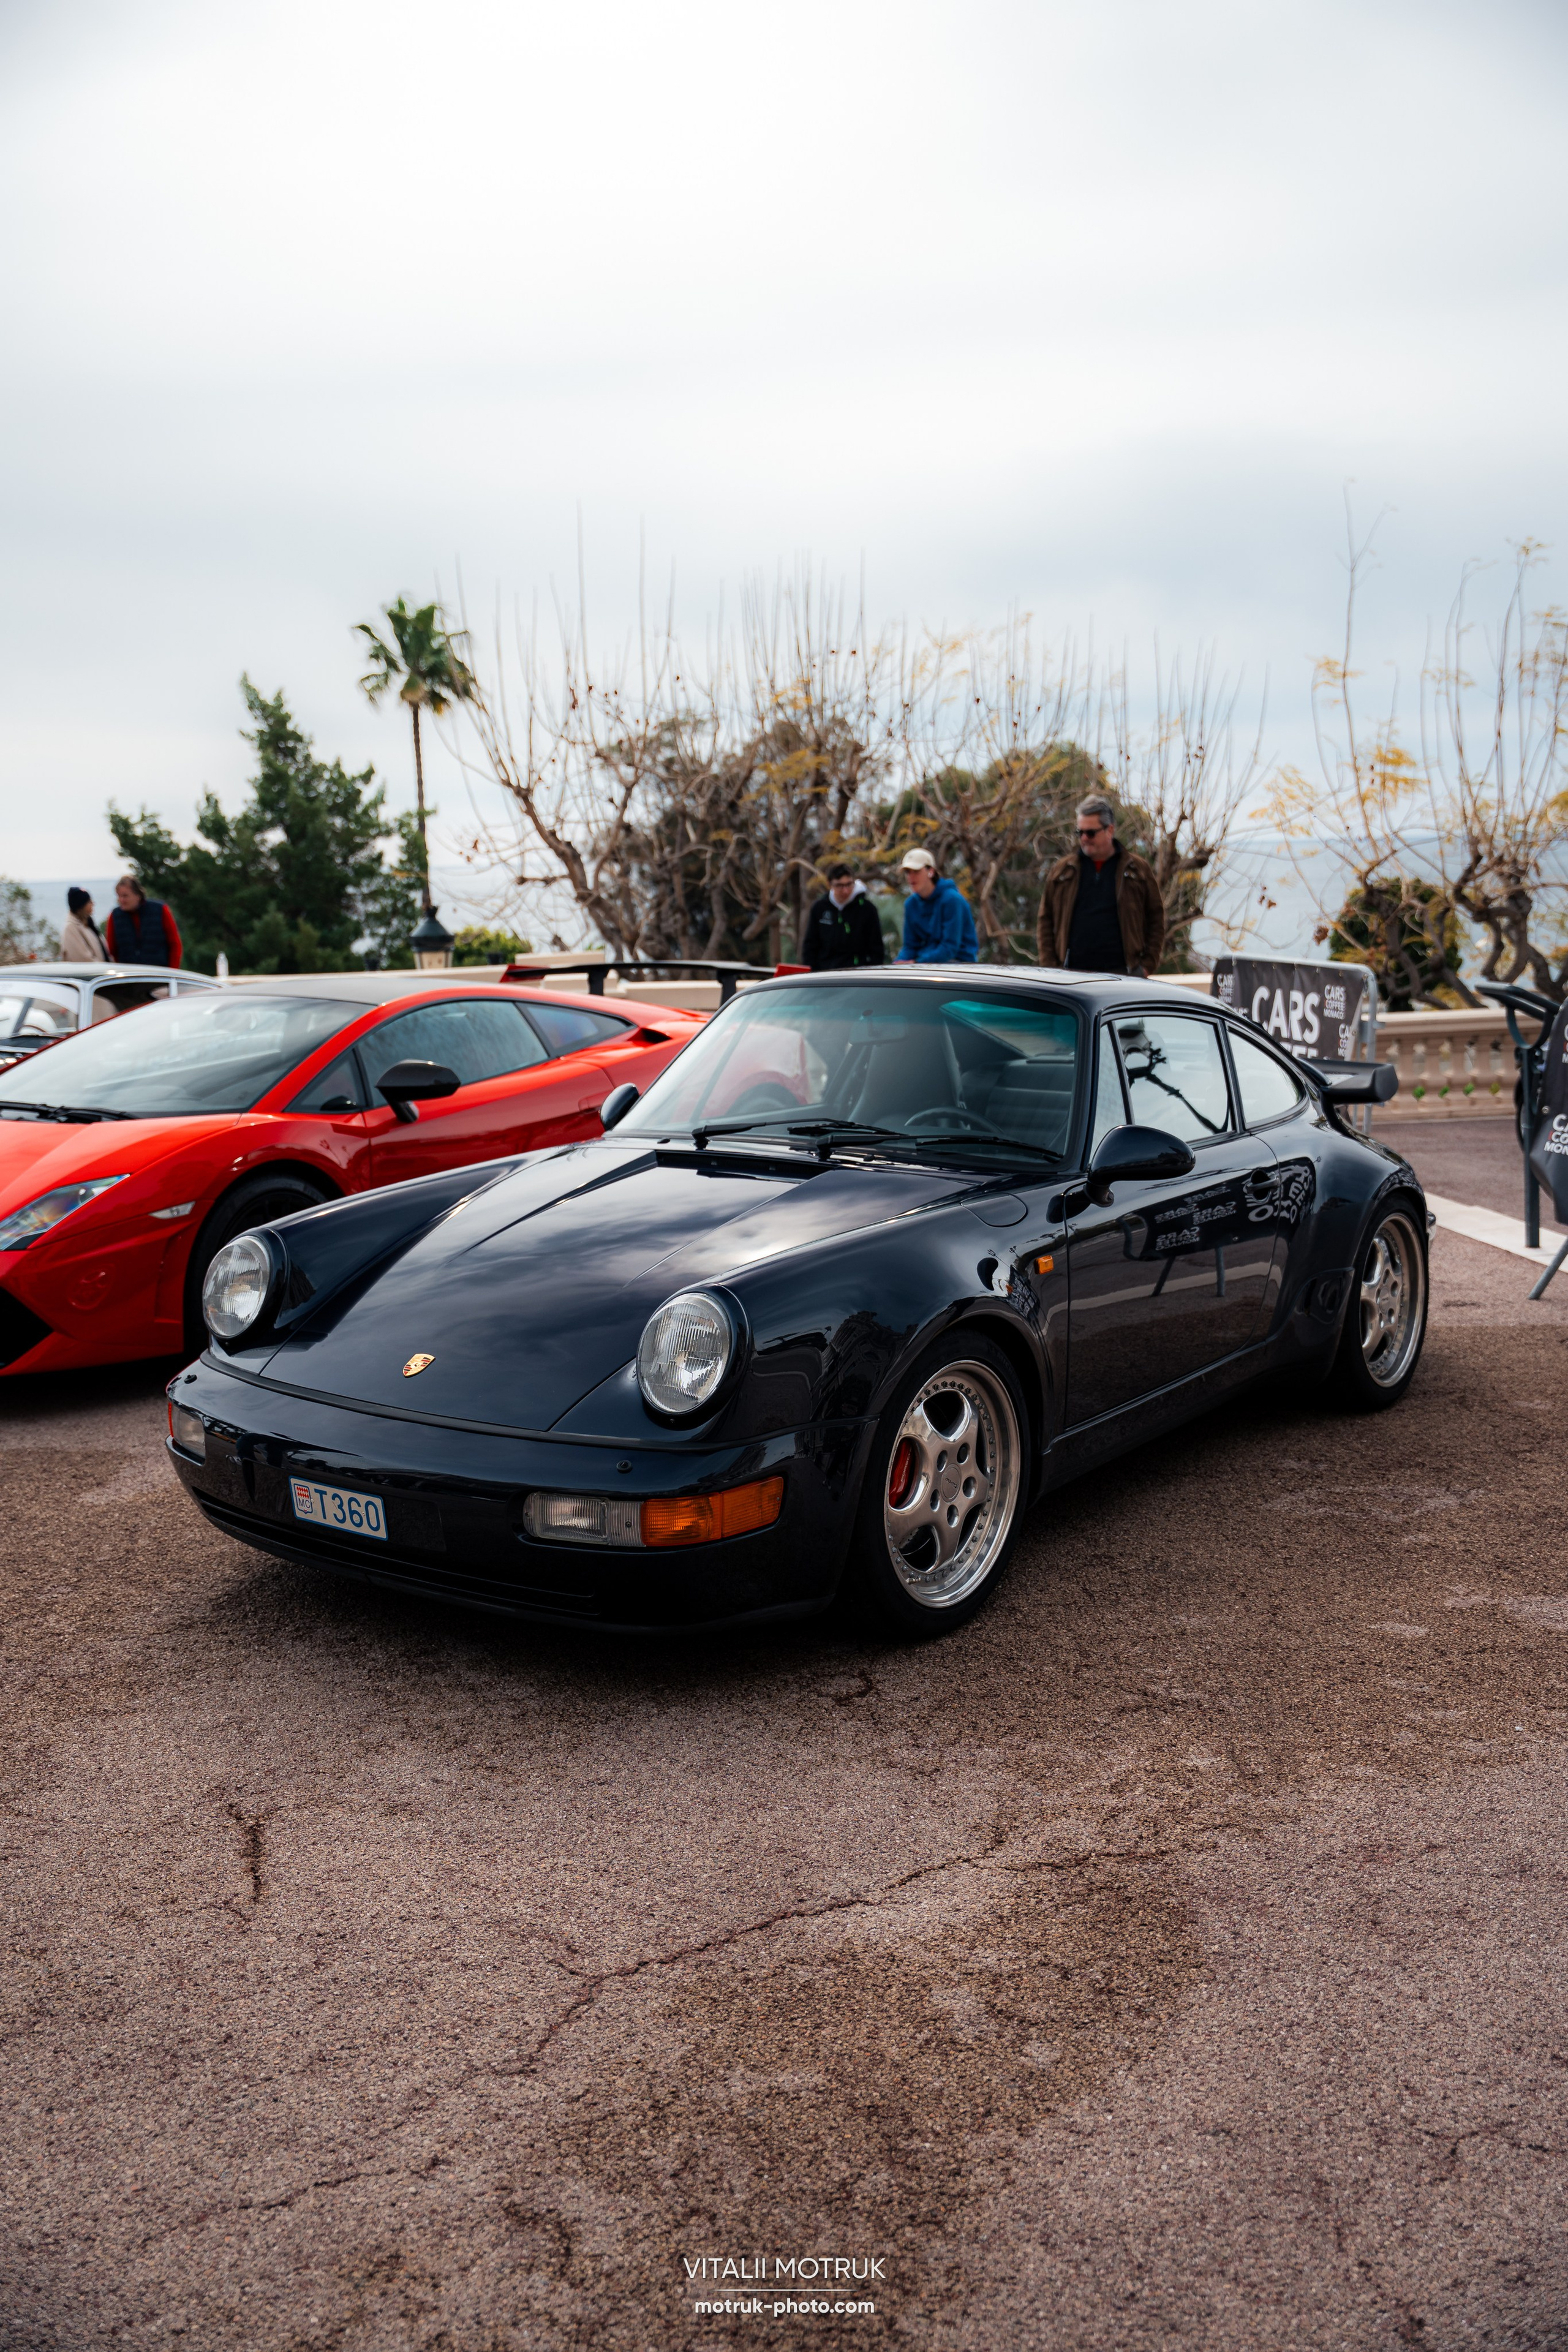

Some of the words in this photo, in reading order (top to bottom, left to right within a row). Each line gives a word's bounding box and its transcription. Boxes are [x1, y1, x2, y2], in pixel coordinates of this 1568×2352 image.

[1324, 984, 1346, 1002] CARS
[1325, 999, 1346, 1012] COFFEE
[1251, 985, 1321, 1044] CARS
[1323, 1008, 1345, 1020] MONACO
[1339, 1023, 1350, 1039] CA
[1544, 1141, 1568, 1156] MON
[298, 1498, 311, 1509] MC
[314, 1488, 381, 1532] T360
